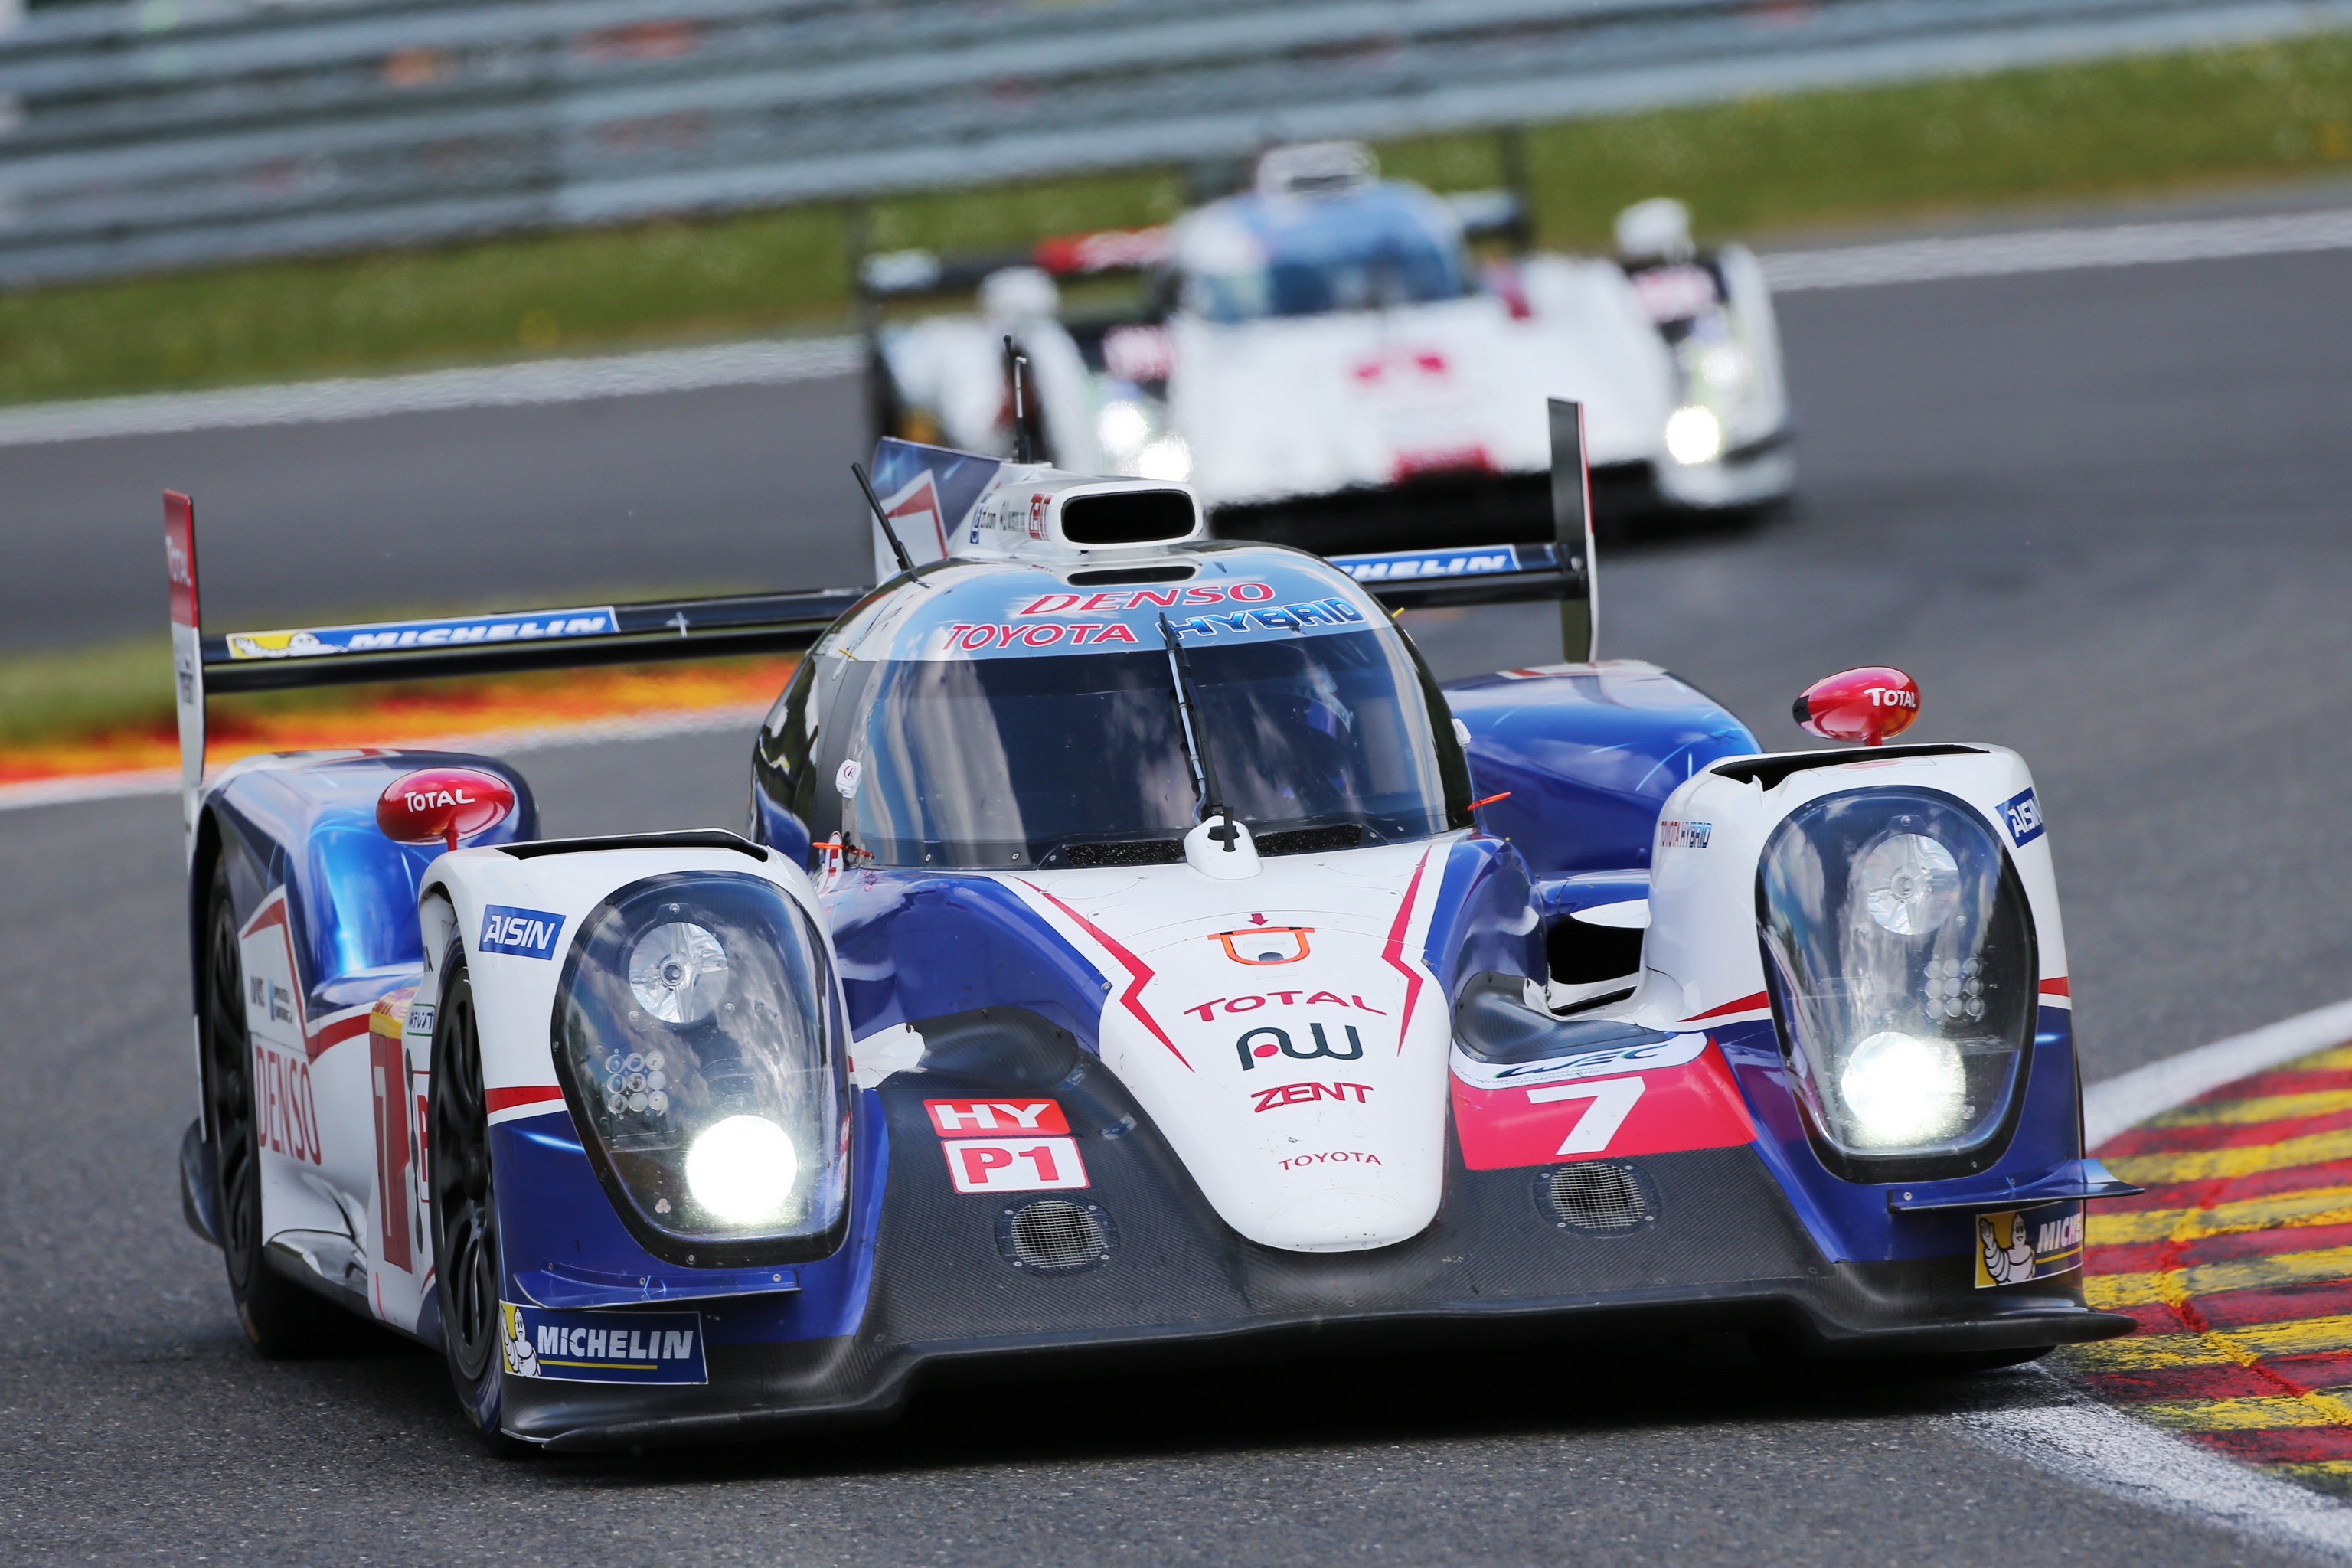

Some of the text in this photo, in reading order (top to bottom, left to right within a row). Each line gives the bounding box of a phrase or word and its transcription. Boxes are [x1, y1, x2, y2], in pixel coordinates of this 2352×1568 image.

[1019, 582, 1276, 615] DENSO
[347, 617, 607, 650] MICHELIN
[942, 596, 1366, 652] TOYOTA HYBRID
[1863, 688, 1916, 709] TOTAL
[404, 789, 475, 813] TOTAL
[2007, 796, 2043, 838] AISIN
[1680, 822, 1712, 848] HYBRID
[483, 915, 556, 950] AISIN
[1184, 991, 1387, 1022] TOTAL
[256, 1046, 322, 1165] DENSO
[1250, 1082, 1374, 1113] ZENT
[933, 1103, 1050, 1130] HY
[1526, 1076, 1647, 1155] 7
[960, 1146, 1060, 1184] P1
[1278, 1152, 1383, 1171] TOYOTA
[537, 1325, 694, 1360] MICHELIN
